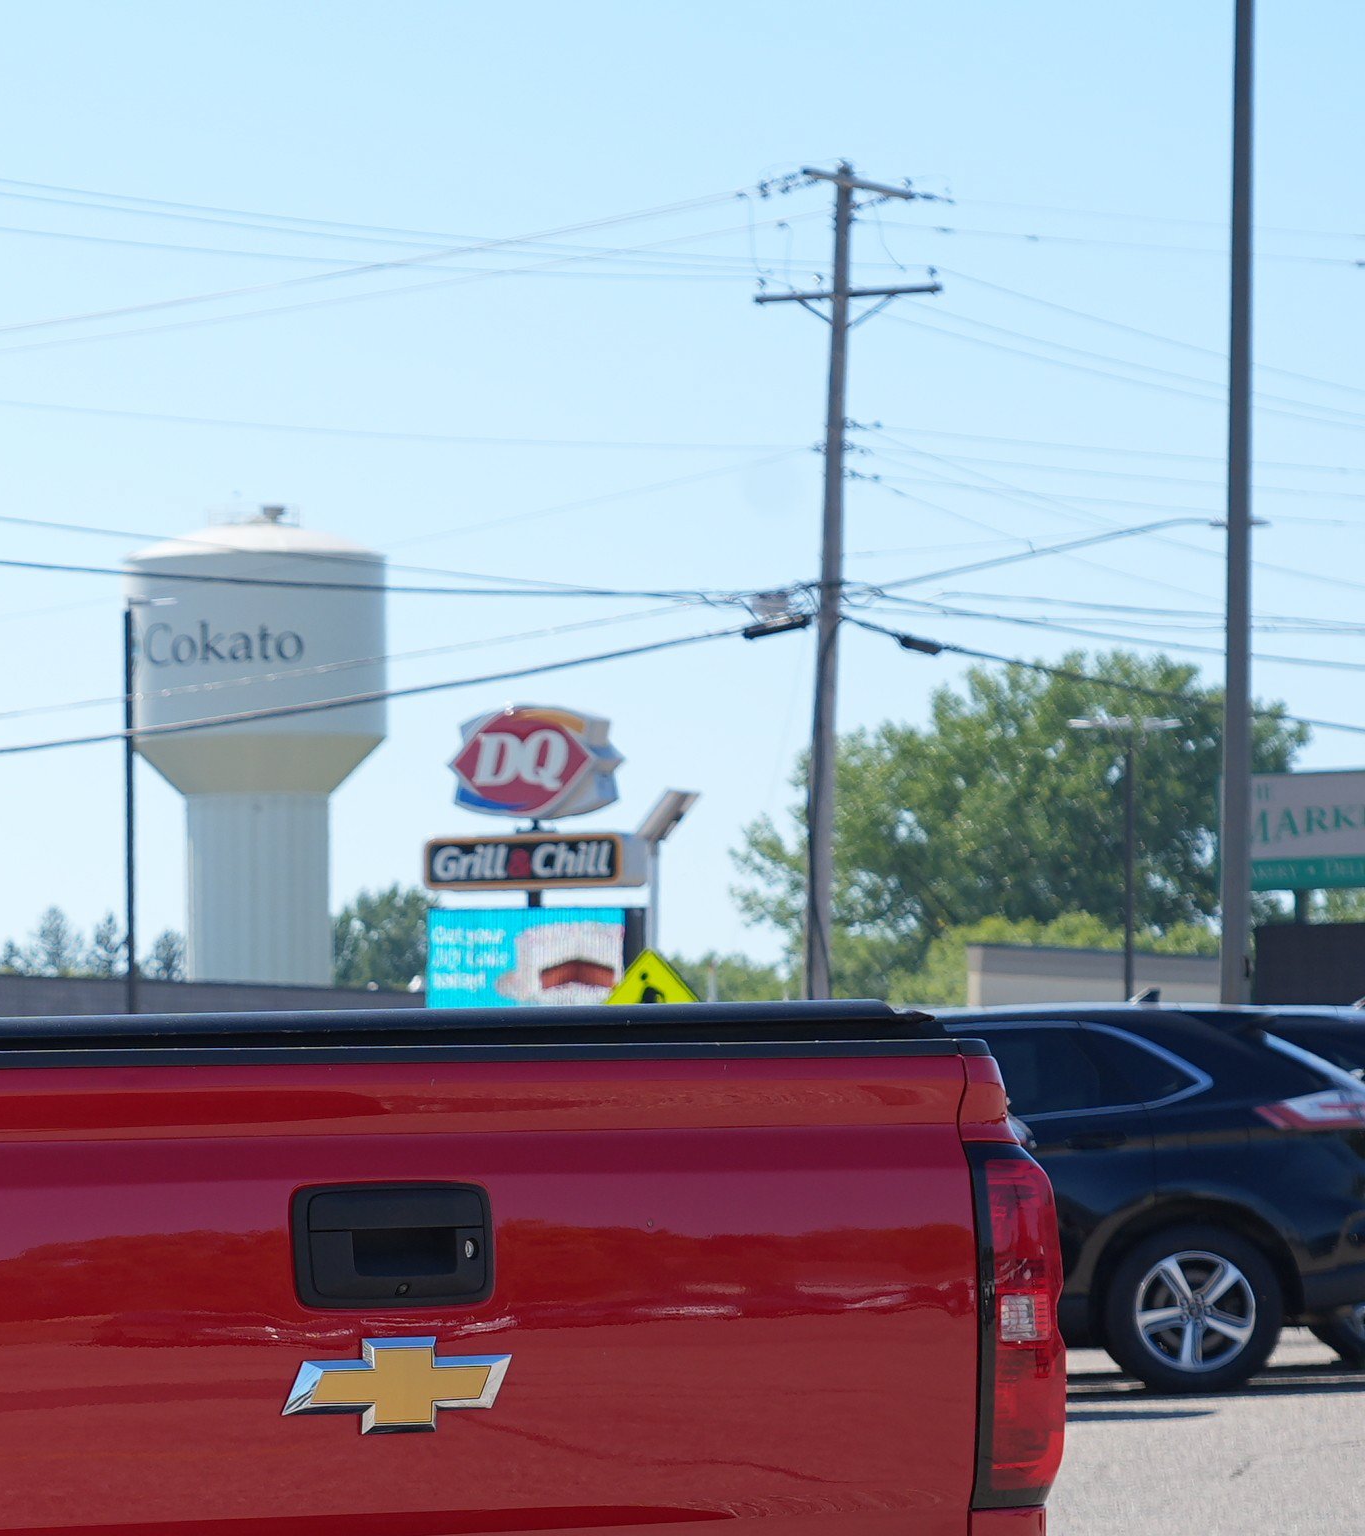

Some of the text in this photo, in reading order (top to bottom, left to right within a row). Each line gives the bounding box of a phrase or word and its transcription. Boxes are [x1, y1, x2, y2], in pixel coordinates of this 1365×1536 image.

[145, 620, 305, 668] Cokato
[471, 728, 569, 790] DQ
[432, 843, 509, 882] Grill
[531, 838, 612, 879] Chill
